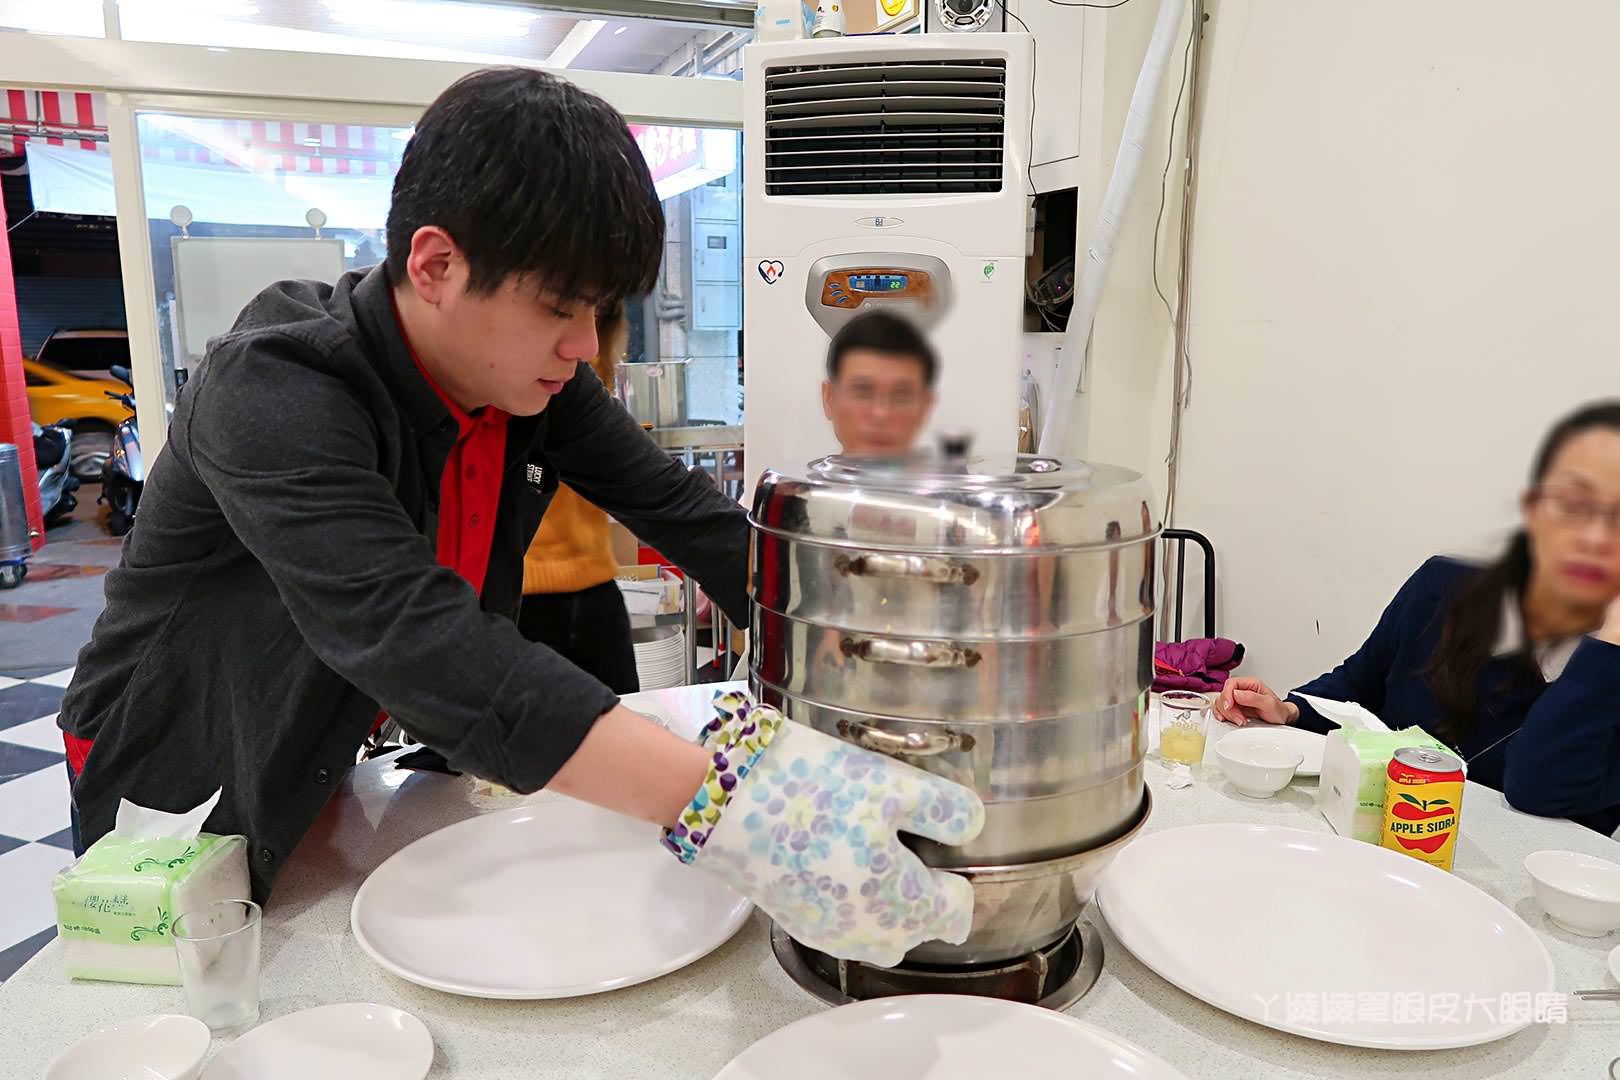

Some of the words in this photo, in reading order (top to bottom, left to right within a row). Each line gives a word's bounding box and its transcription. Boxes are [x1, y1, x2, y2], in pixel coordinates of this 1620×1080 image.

[890, 281, 900, 289] 22
[1390, 821, 1424, 834] APPLE
[1426, 816, 1455, 833] SIDRA
